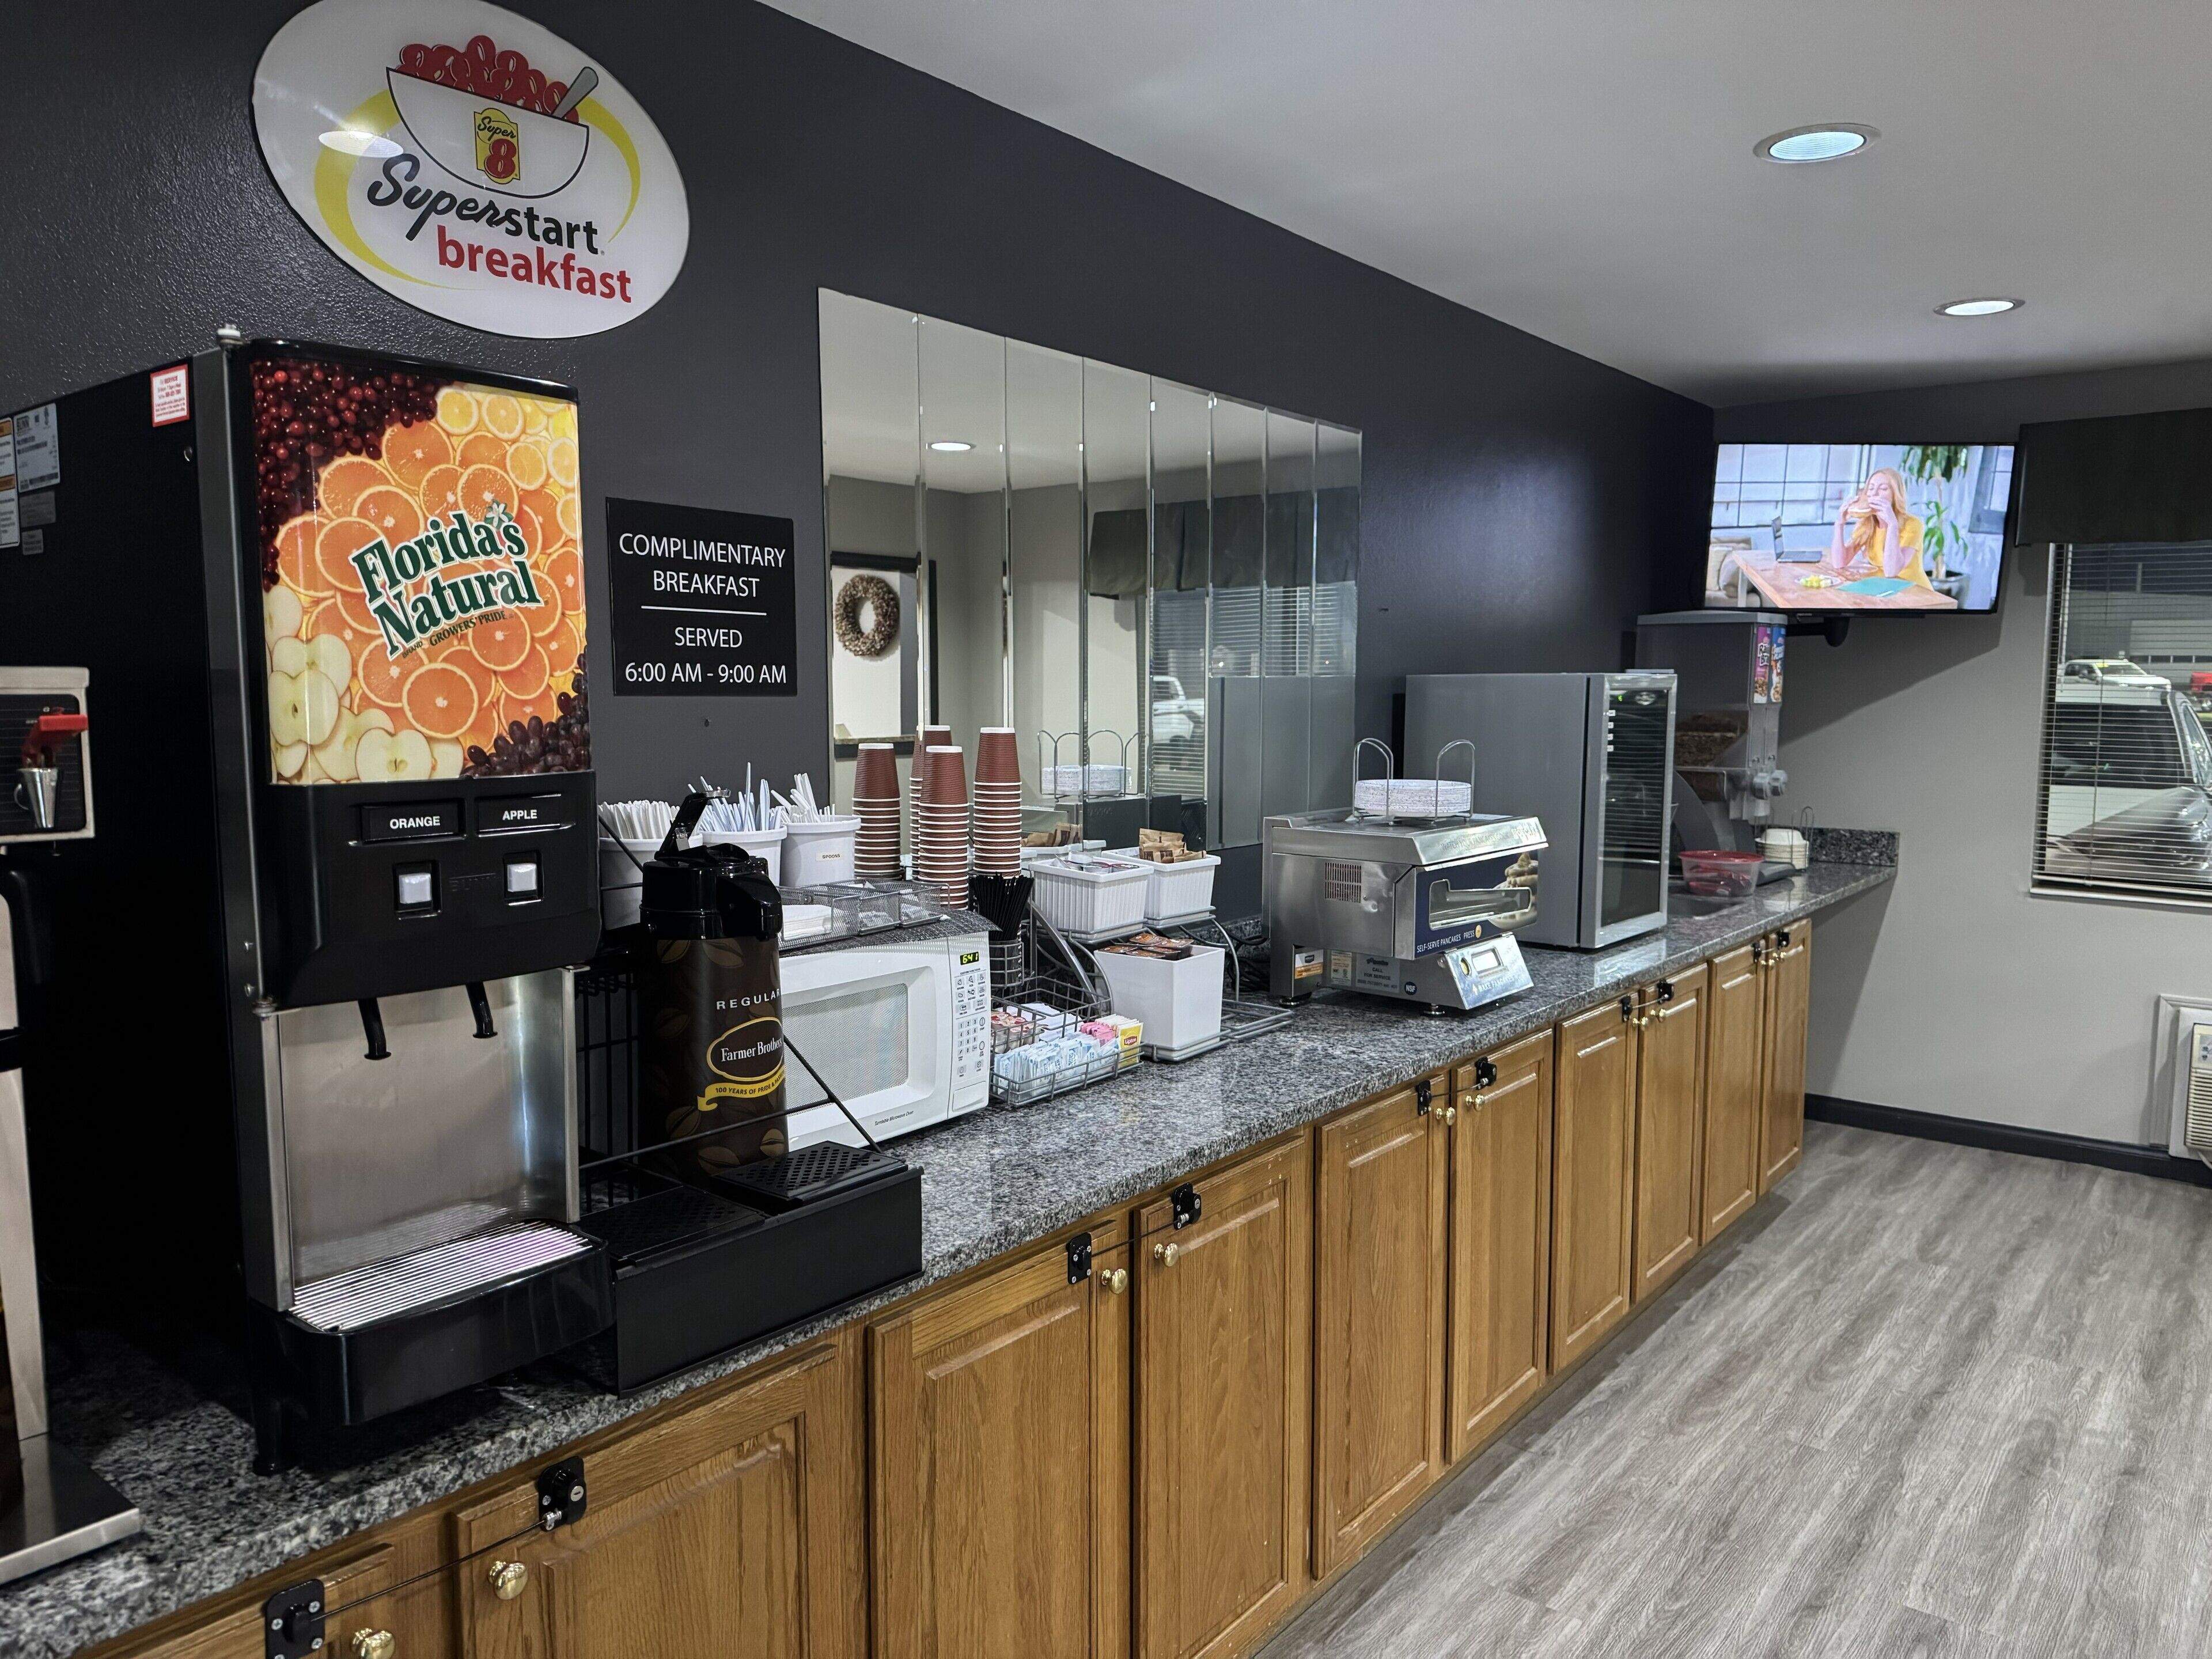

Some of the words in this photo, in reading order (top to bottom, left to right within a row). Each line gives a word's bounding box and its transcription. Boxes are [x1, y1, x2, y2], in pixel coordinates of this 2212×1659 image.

[478, 116, 516, 142] Super
[484, 138, 517, 179] 8
[437, 225, 632, 304] breakfast
[619, 533, 786, 567] COMPLIMENTARY
[653, 570, 760, 597] BREAKFAST
[373, 560, 541, 656] Natural
[478, 611, 506, 625] PRIDE
[675, 627, 743, 647] SERVED
[625, 662, 666, 682] 6:00
[671, 662, 702, 682] AM
[718, 664, 754, 683] 9:00
[759, 665, 786, 683] AM
[389, 816, 440, 830] ORANGE
[502, 809, 537, 820] APPLE
[1417, 940, 1440, 953] SELF-SERVE
[1440, 934, 1461, 946] PANCAKES
[1463, 930, 1475, 940] PRESS
[1478, 983, 1491, 992] MAKE
[717, 988, 781, 1010] REGULAR
[721, 1047, 756, 1062] Farmer
[757, 1037, 782, 1055] Brothers
[757, 1084, 771, 1093] PRIDE
